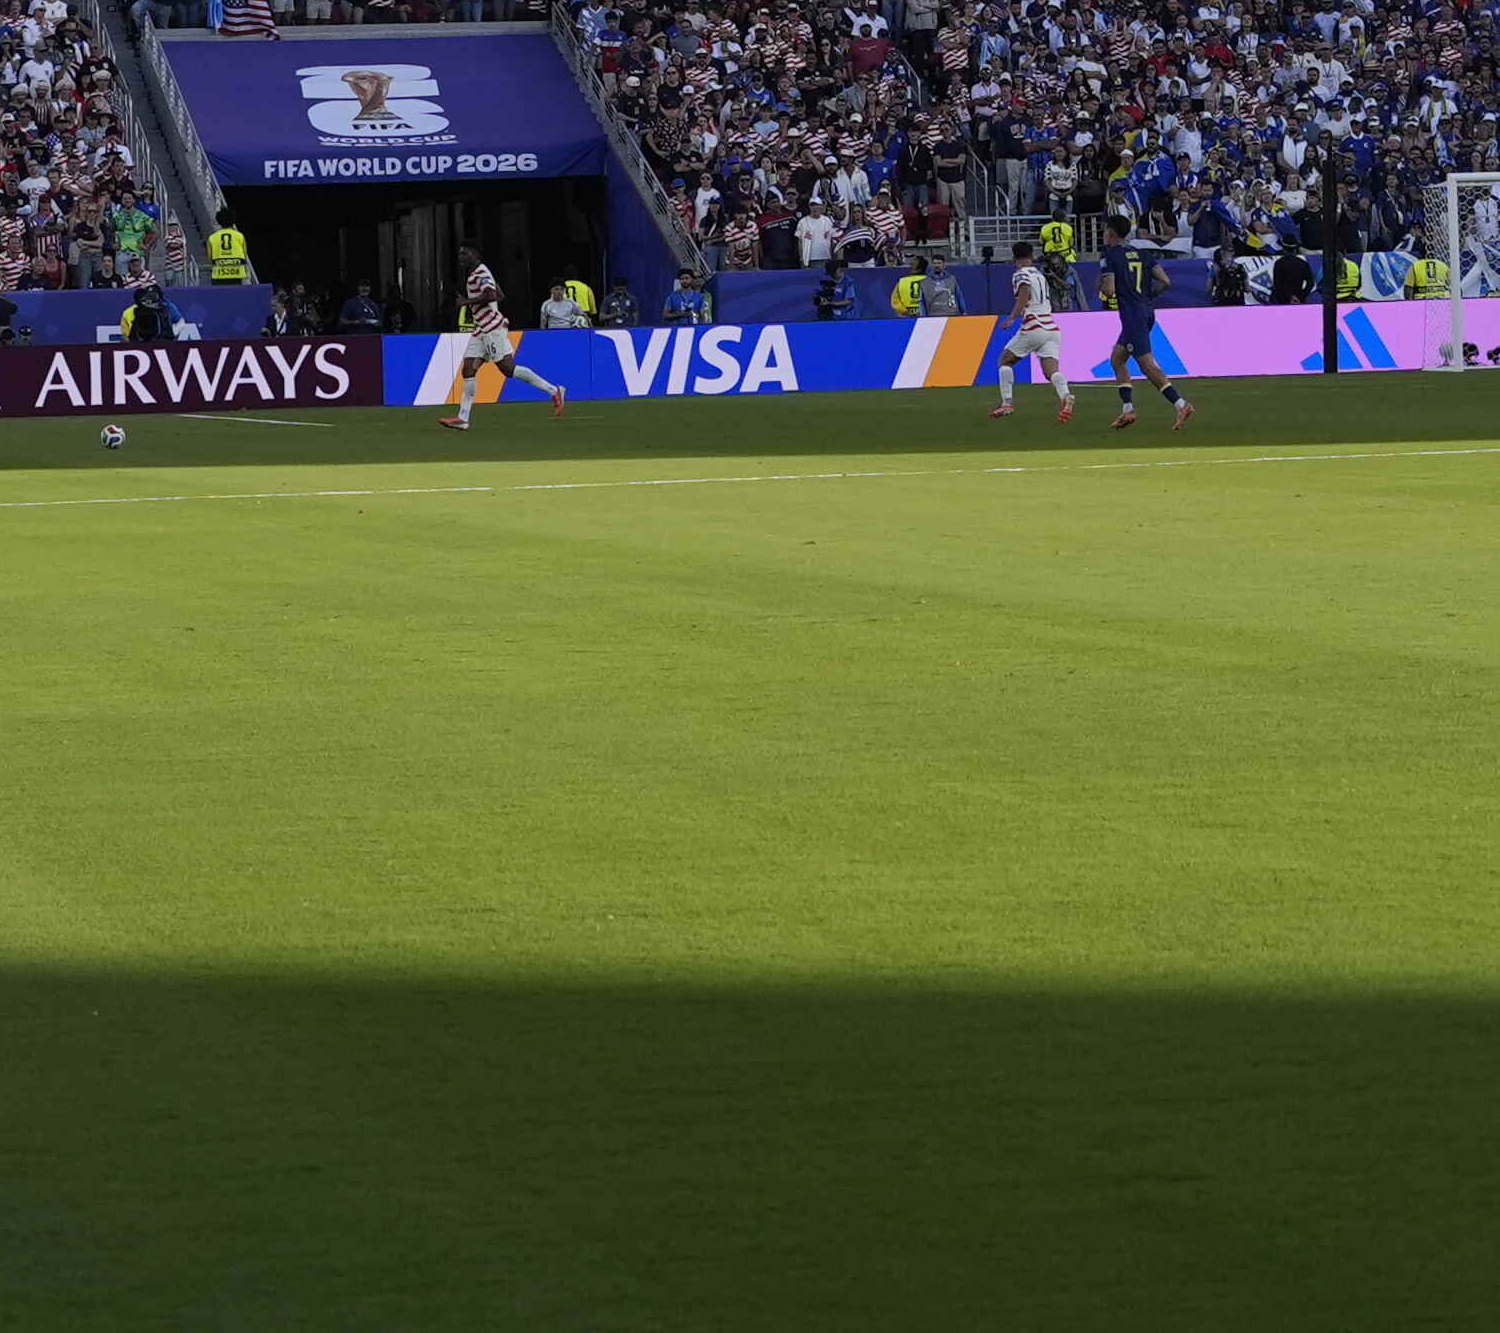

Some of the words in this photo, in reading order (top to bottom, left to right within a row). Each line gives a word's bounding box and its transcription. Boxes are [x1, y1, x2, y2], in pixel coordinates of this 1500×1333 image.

[318, 134, 390, 145] WORLD
[395, 134, 459, 145] CUP
[352, 121, 414, 131] FIFA
[264, 159, 315, 179] FIFA
[318, 157, 402, 178] WORLD
[404, 155, 453, 176] CUP
[456, 152, 539, 174] 2026
[1128, 261, 1143, 294] 7
[35, 342, 351, 409] AIRWAYS
[594, 324, 799, 397] VISA
